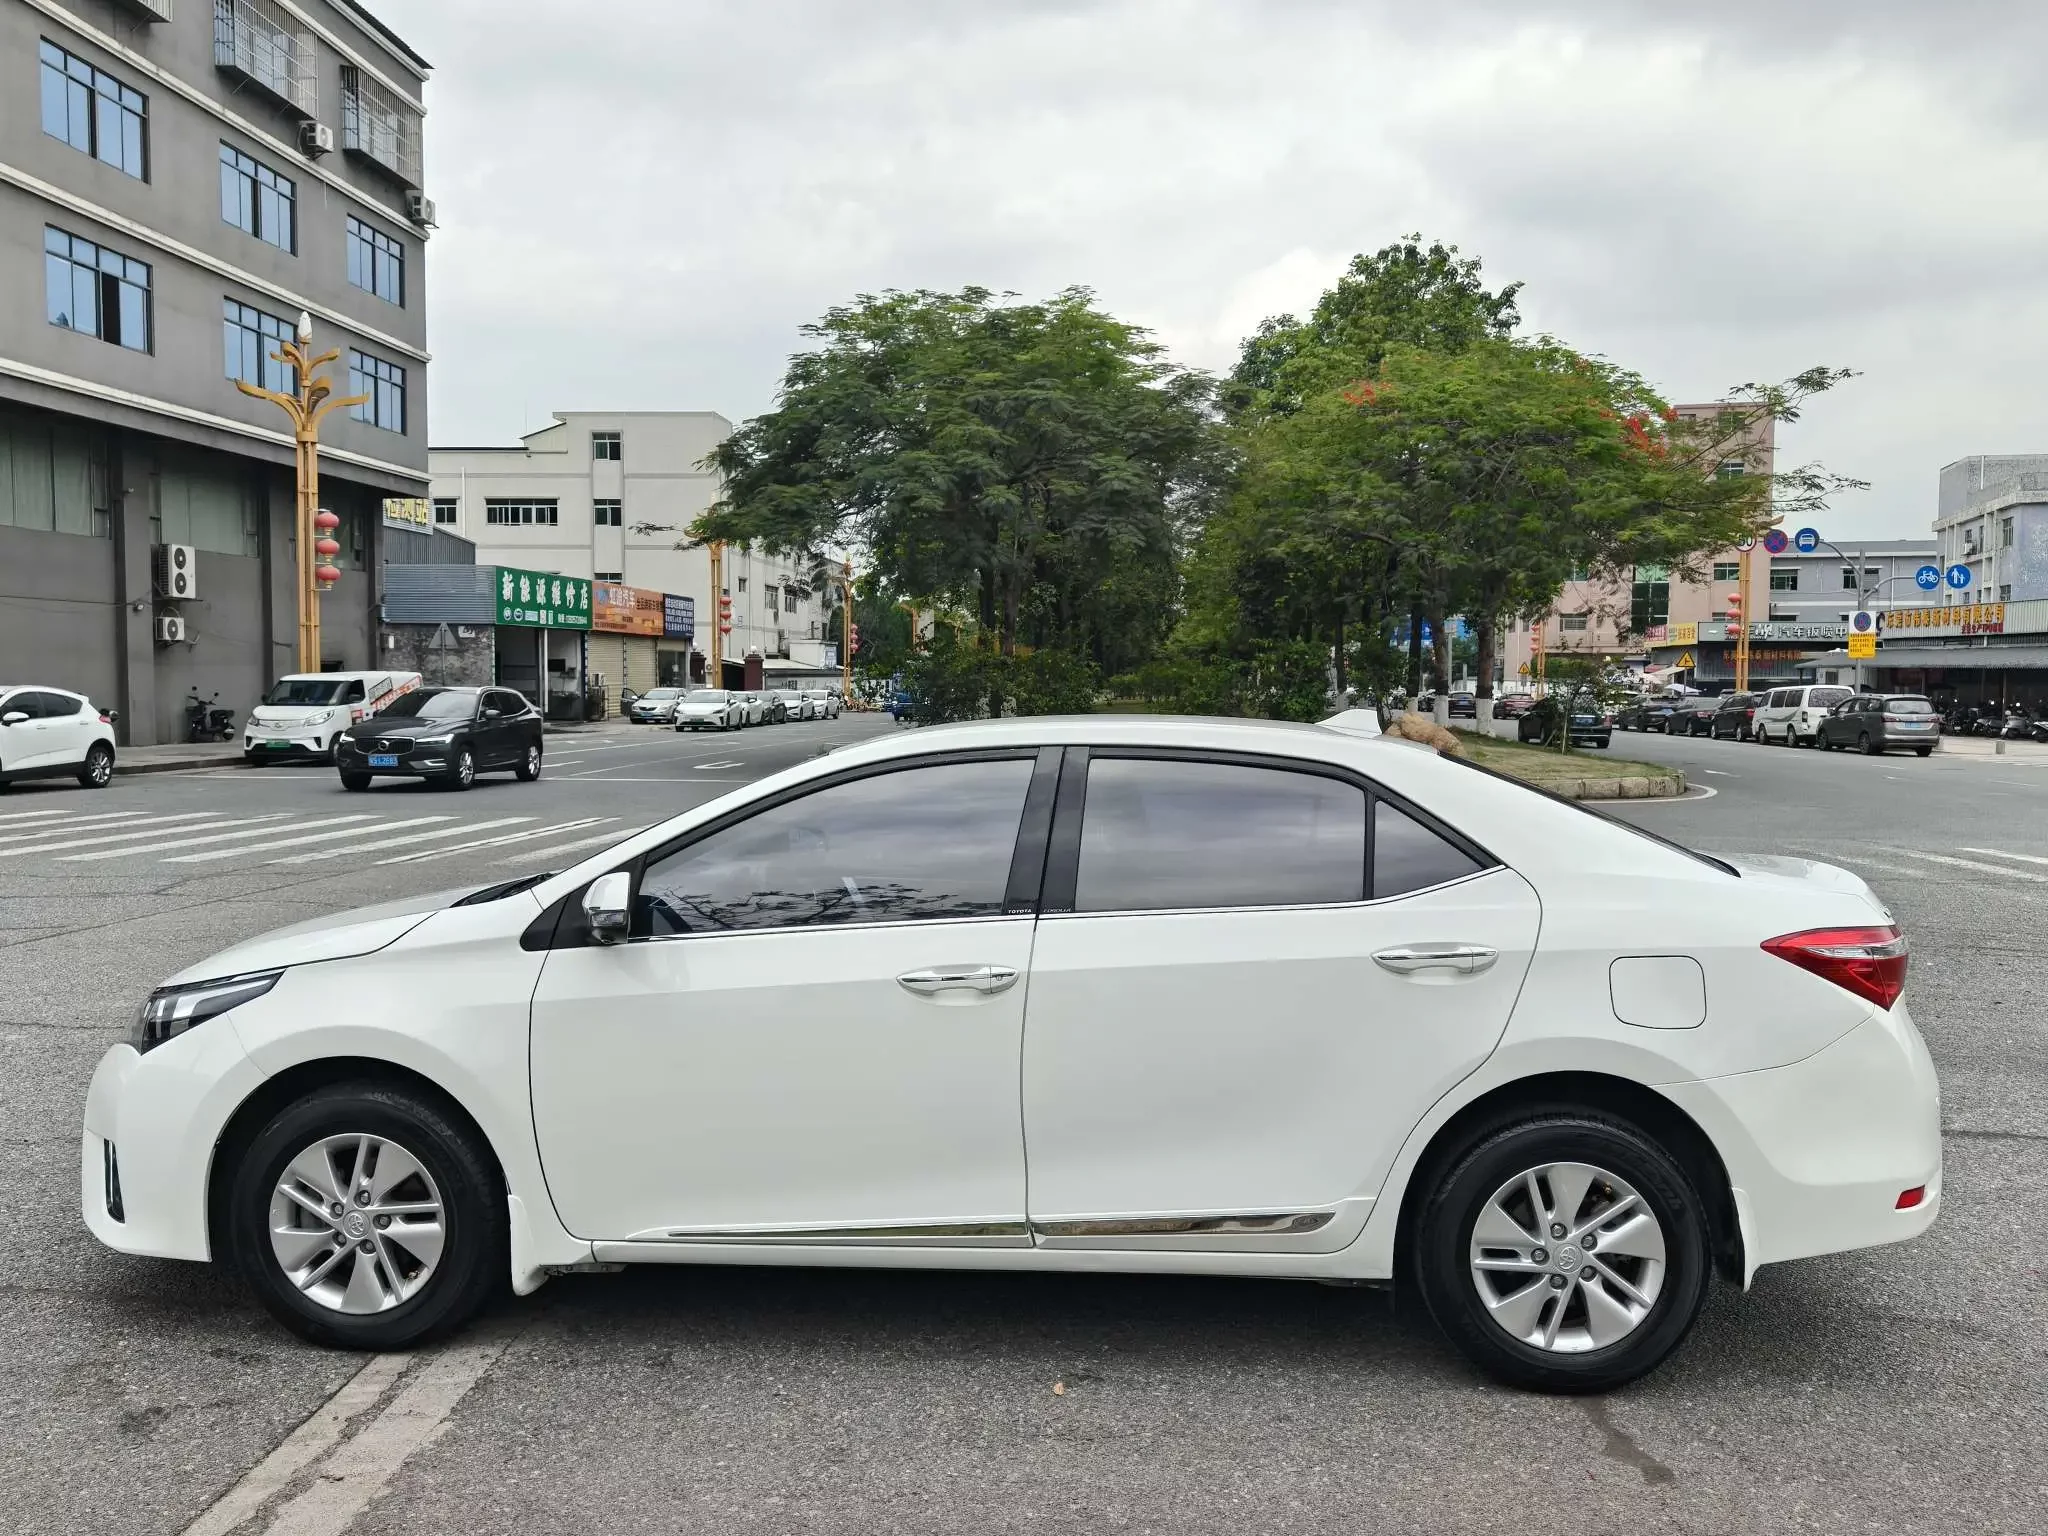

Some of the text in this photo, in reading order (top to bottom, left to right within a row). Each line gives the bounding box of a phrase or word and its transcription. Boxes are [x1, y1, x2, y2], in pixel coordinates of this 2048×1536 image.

[502, 571, 588, 609] 新能源维修店
